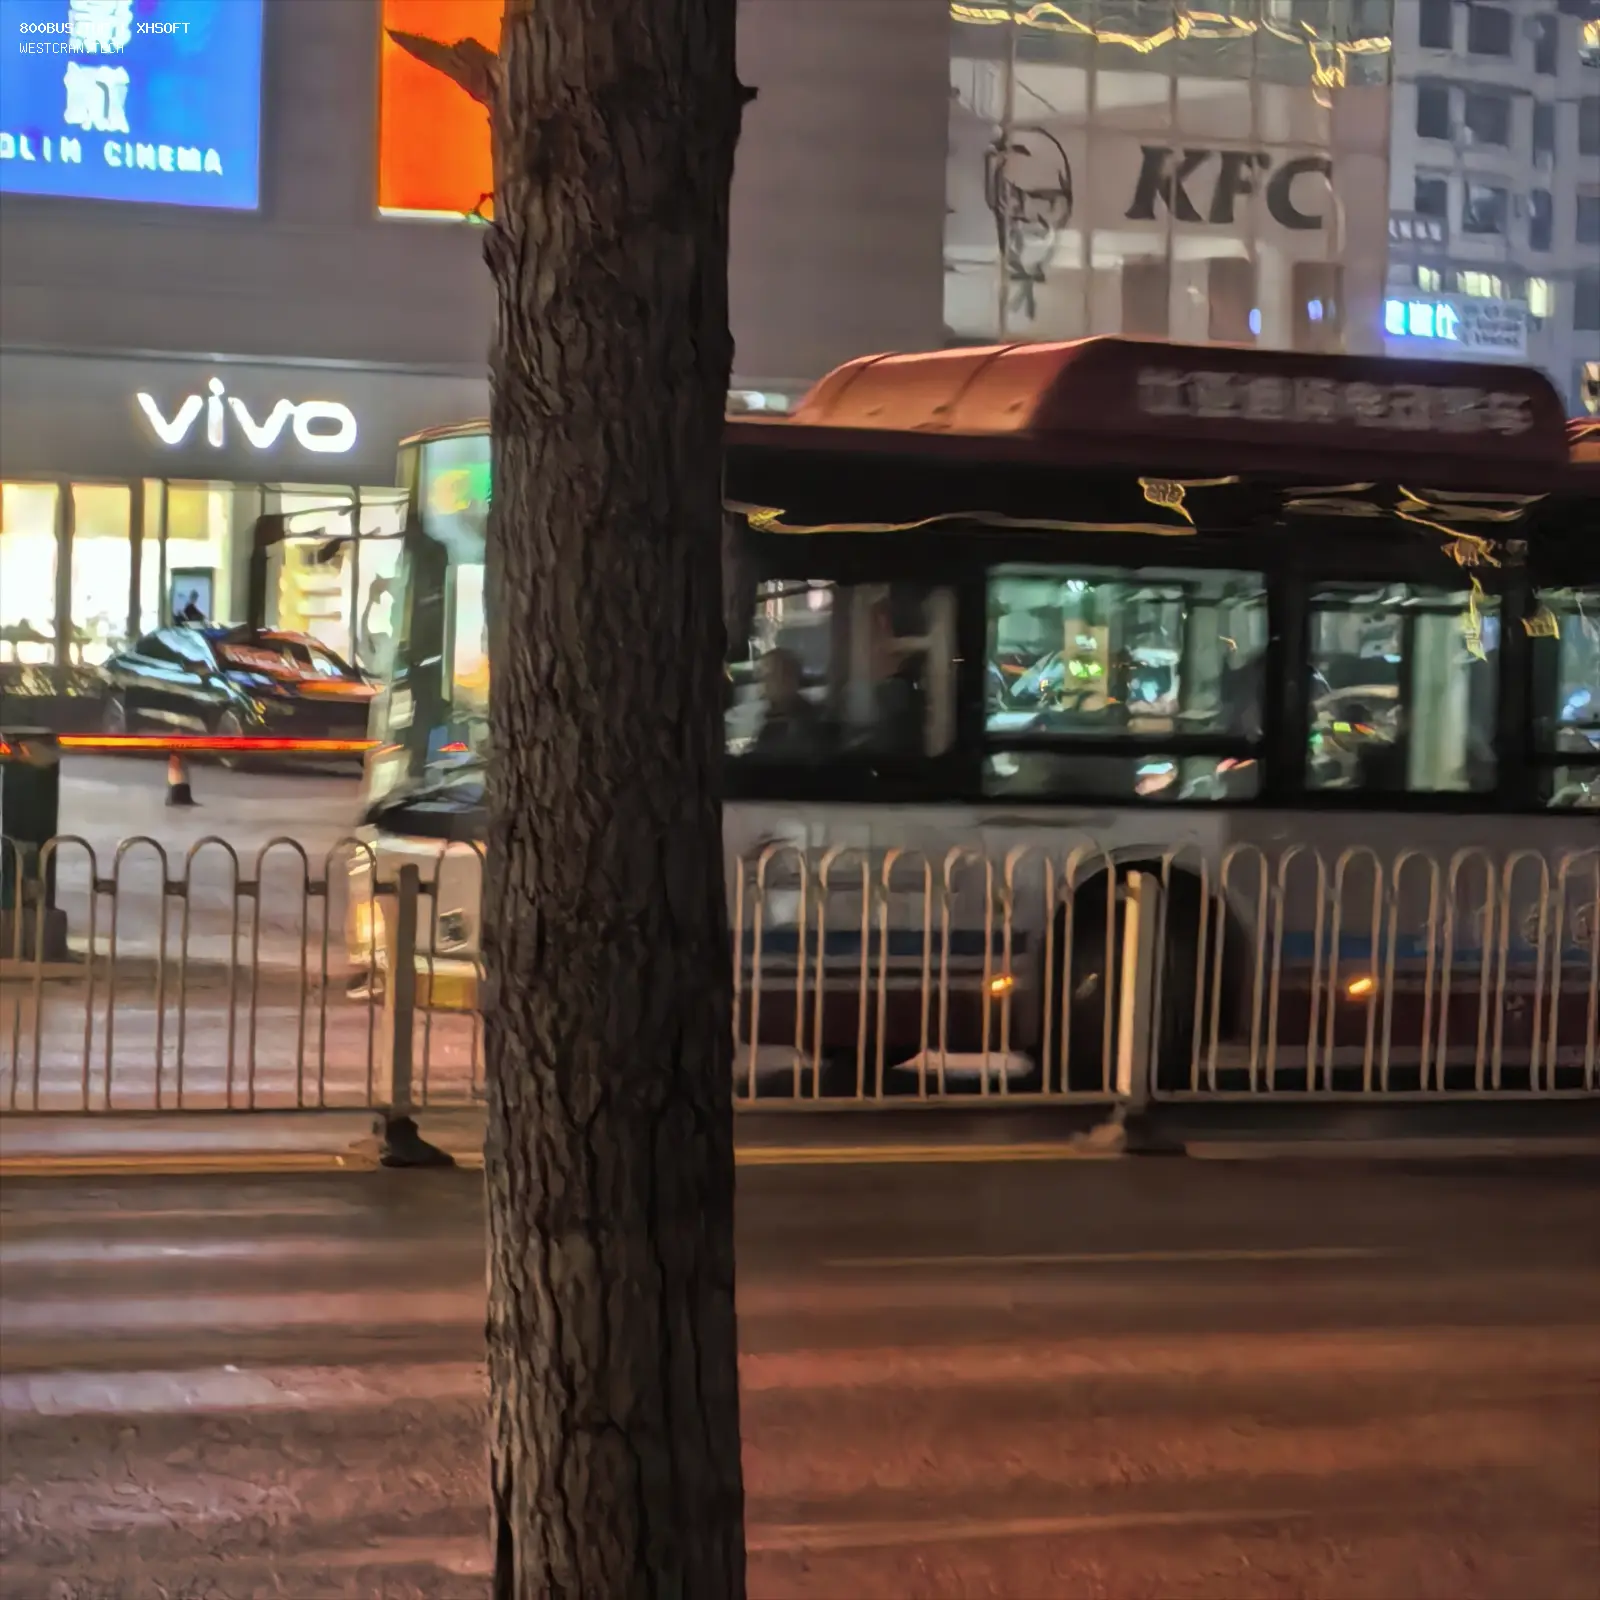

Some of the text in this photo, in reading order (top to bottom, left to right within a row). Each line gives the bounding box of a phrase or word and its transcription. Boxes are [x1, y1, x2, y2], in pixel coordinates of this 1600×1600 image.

[103, 140, 223, 176] CINEMA
[1124, 145, 1333, 230] KFC
[136, 377, 357, 452] vivo
